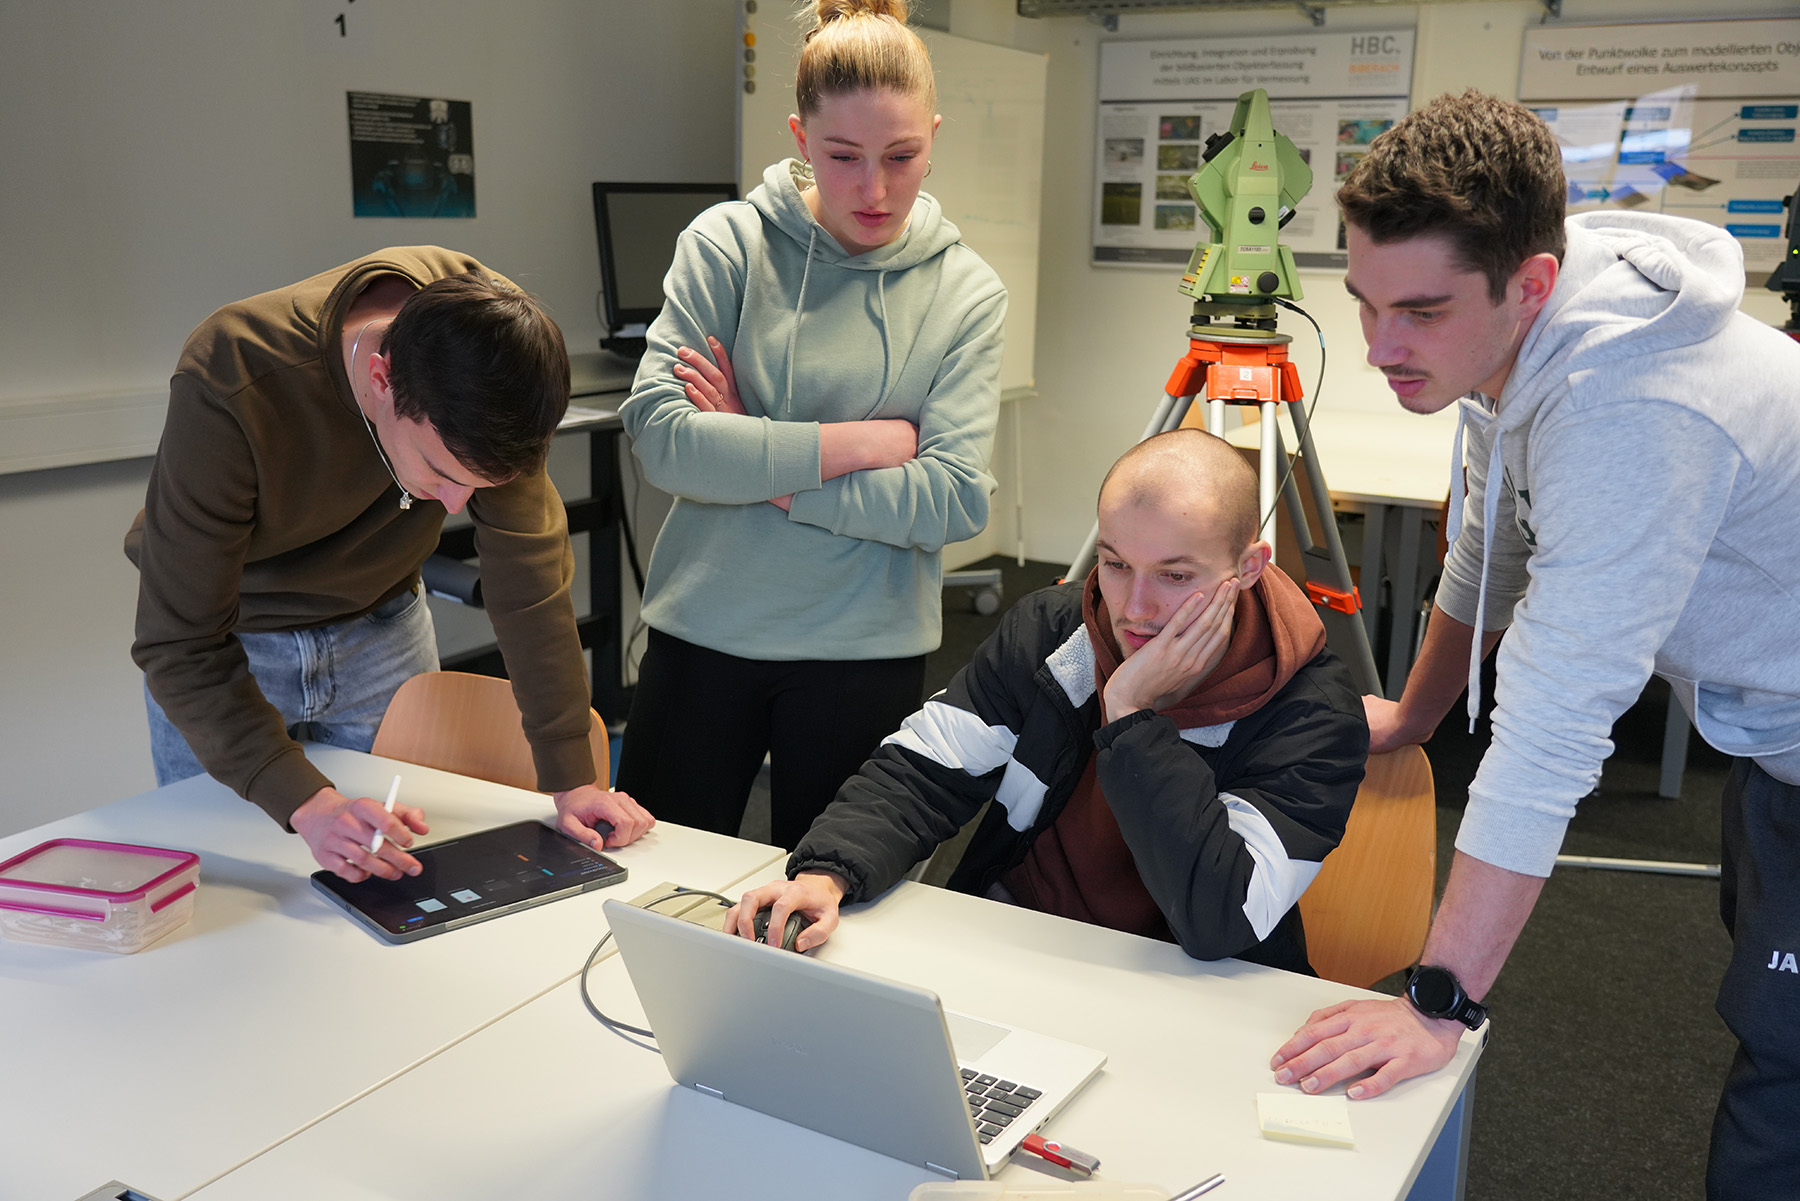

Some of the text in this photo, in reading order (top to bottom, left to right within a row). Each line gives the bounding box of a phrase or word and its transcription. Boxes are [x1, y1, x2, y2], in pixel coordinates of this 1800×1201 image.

[335, 13, 346, 37] 1
[1251, 47, 1266, 56] und
[1538, 49, 1561, 60] Von
[1564, 48, 1583, 59] der
[1587, 46, 1657, 59] Punktwolke
[1661, 47, 1688, 58] zum
[1691, 43, 1772, 56] modellierten
[1577, 60, 1779, 75] Entwurf eines Auswertekonzepts
[1249, 160, 1268, 171] Leica
[1243, 370, 1249, 379] 2
